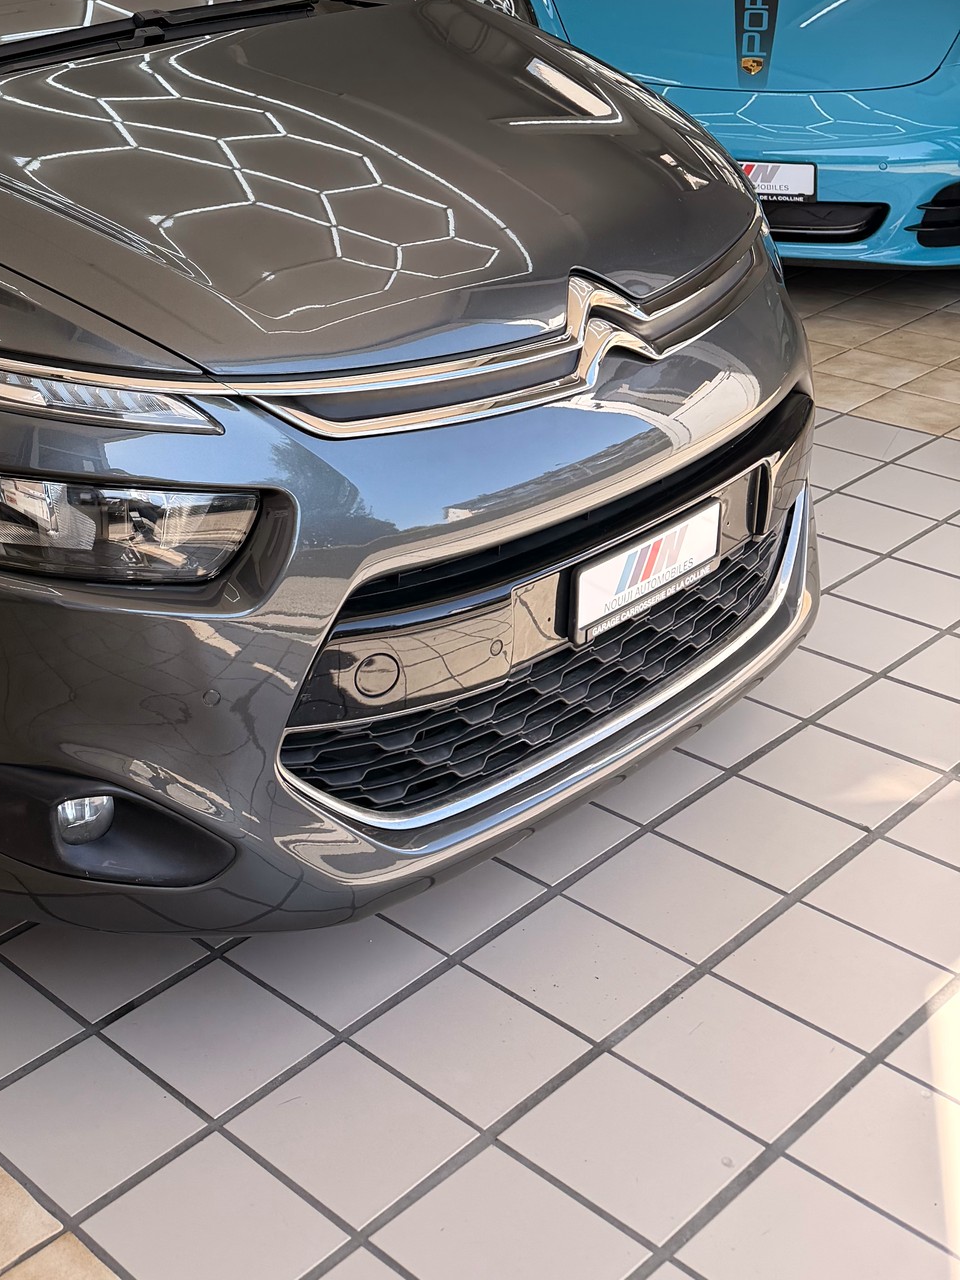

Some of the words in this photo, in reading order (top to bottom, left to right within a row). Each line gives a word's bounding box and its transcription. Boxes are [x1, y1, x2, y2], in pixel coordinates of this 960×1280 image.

[592, 615, 620, 636] GARAGE
[620, 590, 666, 621] CARROSSERIE
[666, 585, 676, 597] DE
[675, 580, 685, 592] LA
[684, 565, 711, 585] COLLINE
[604, 592, 634, 614] NOUIJI
[635, 558, 694, 598] AUTOMOBILES
